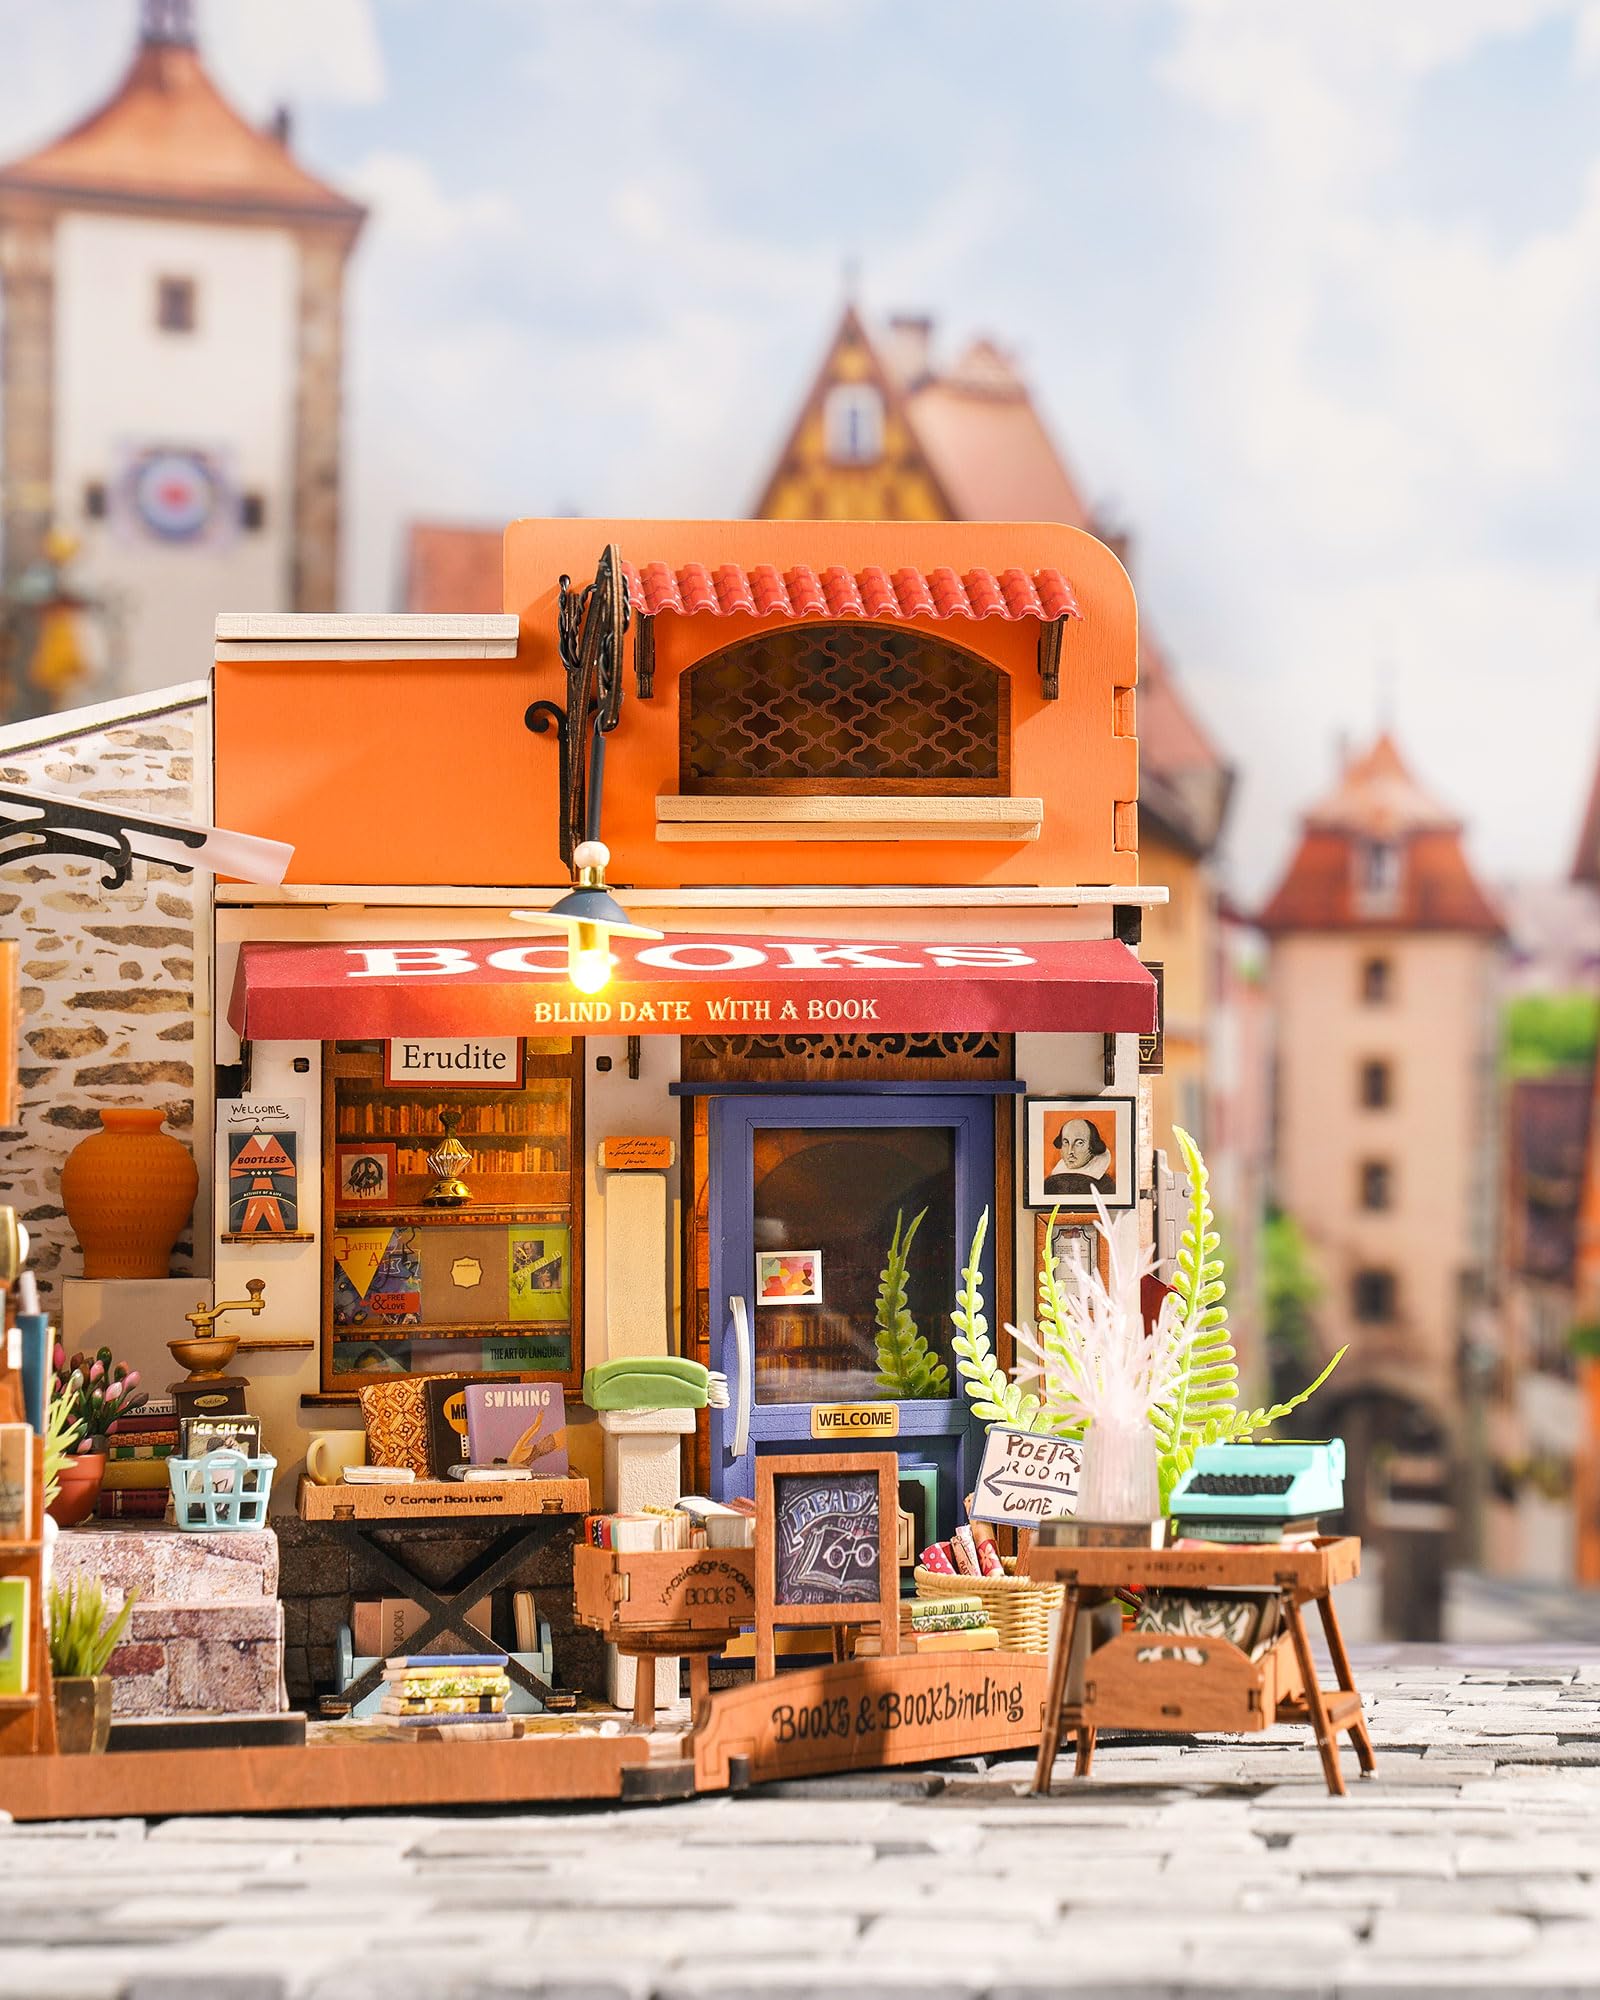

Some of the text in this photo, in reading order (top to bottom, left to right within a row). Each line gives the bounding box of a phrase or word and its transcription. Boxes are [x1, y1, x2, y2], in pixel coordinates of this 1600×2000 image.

[346, 943, 1036, 977] BOOKS
[534, 997, 880, 1022] BLIND DATE WITH A BOOK
[402, 1043, 507, 1070] Erudite
[231, 1104, 286, 1115] WELCOME
[238, 1156, 287, 1165] BOOTLESS
[490, 1348, 504, 1360] THE
[504, 1347, 518, 1360] ART
[484, 1390, 551, 1408] SWIMING
[135, 1407, 146, 1415] OF
[148, 1406, 173, 1414] NATU
[451, 1403, 467, 1420] MA
[819, 1412, 892, 1426] WELCOME
[215, 1422, 256, 1436] CREAM
[789, 1487, 862, 1534] READ
[959, 1561, 973, 1576] PLAT
[685, 1586, 736, 1606] BOOKS
[923, 1605, 938, 1616] EGO
[941, 1604, 956, 1614] AND
[855, 1695, 876, 1736] &
